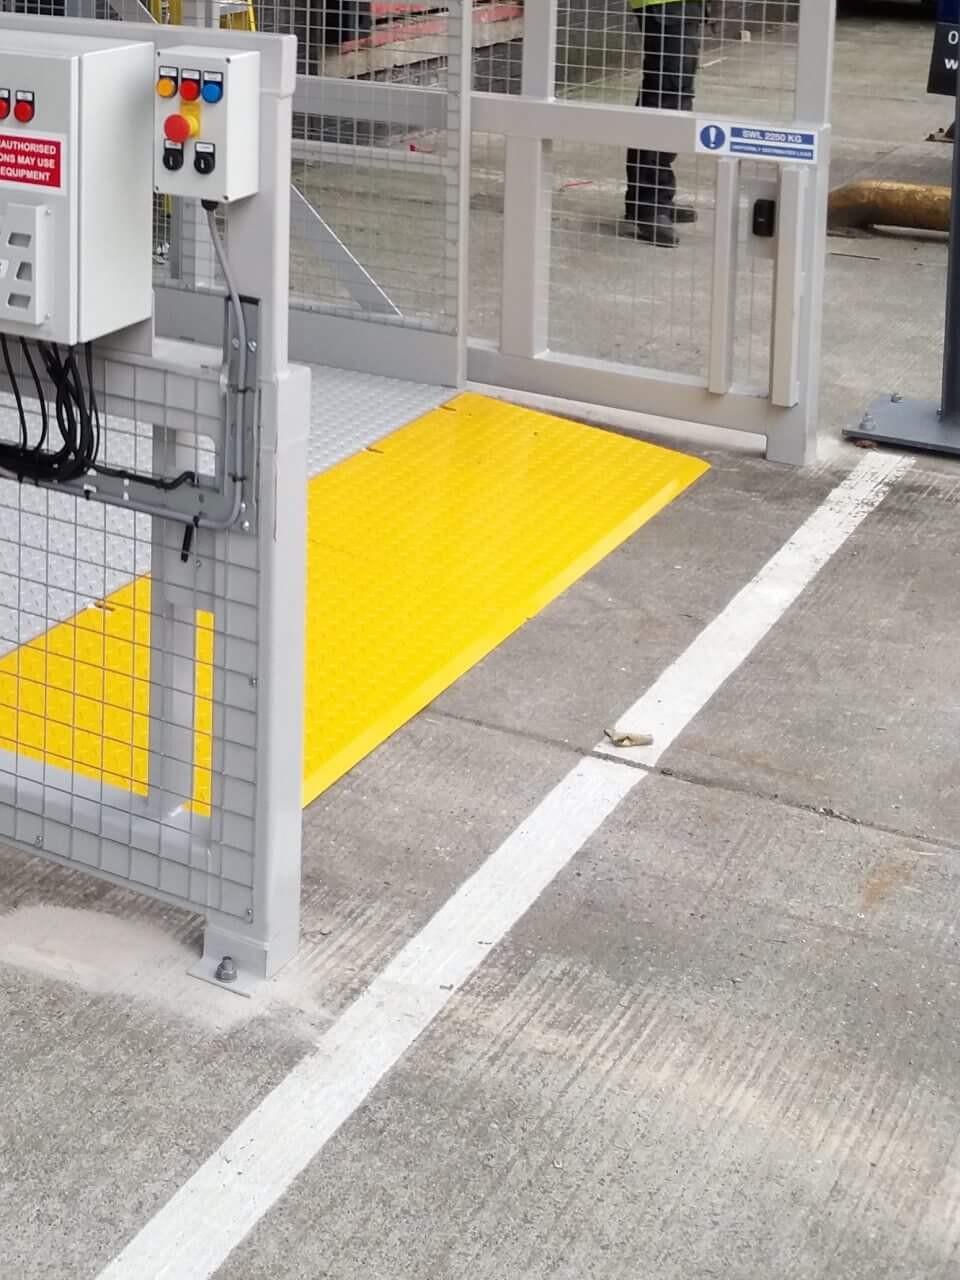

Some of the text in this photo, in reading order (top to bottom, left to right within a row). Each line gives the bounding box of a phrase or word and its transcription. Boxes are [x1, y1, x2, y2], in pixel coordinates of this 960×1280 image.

[765, 131, 786, 142] 2250
[787, 134, 802, 143] KG
[17, 155, 36, 166] MAY
[37, 157, 55, 169] USE
[0, 166, 51, 182] EQUIPMENT
